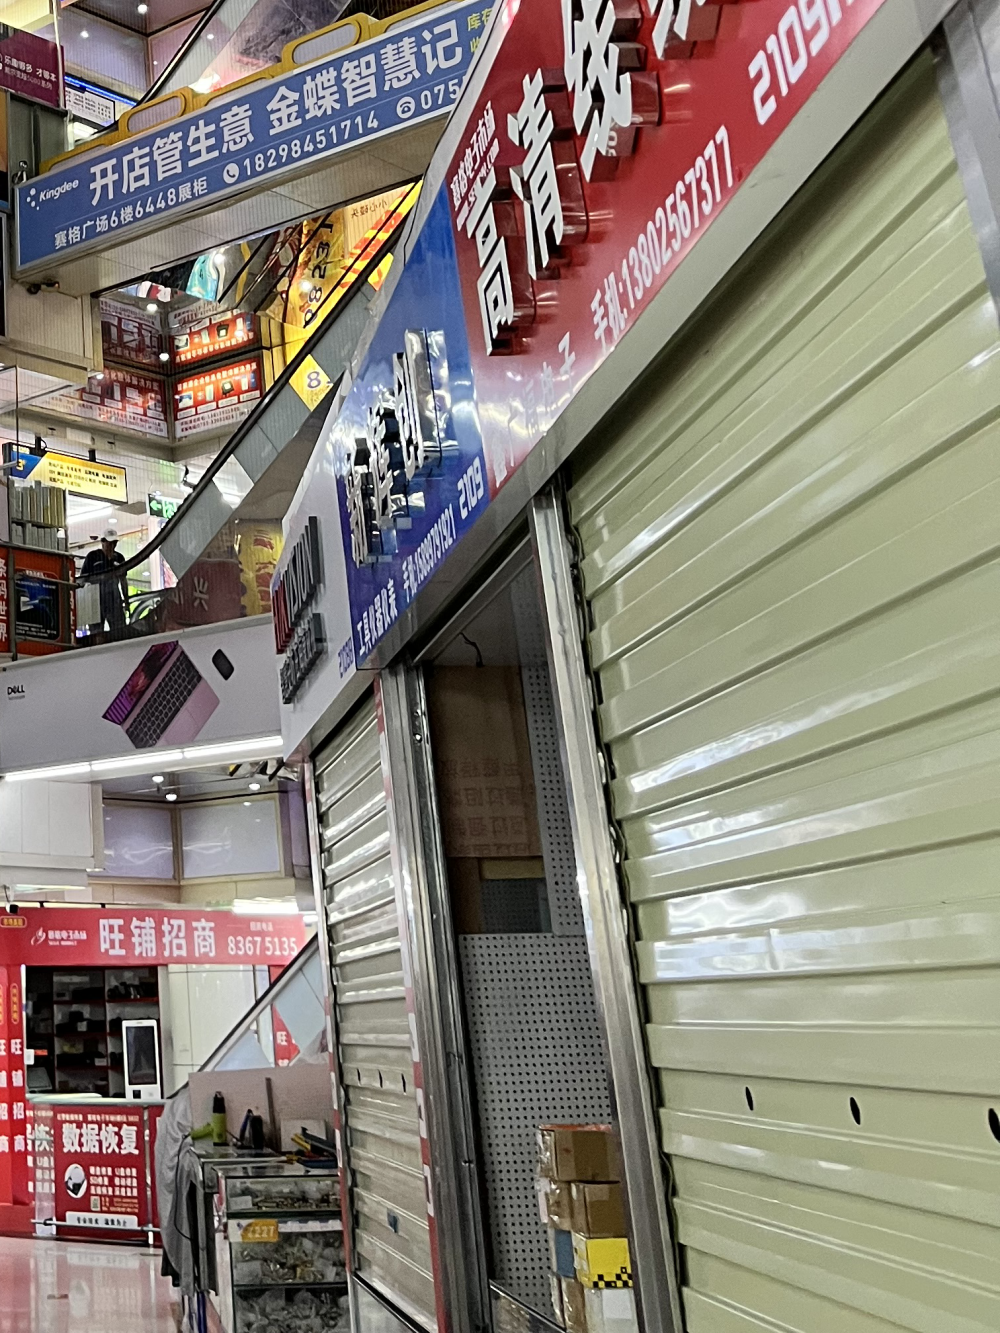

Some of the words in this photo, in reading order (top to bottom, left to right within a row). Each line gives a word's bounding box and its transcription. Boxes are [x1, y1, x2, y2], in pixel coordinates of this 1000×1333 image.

[88, 102, 254, 207] 开店管生意
[266, 18, 463, 132] 金蝶智慧记
[38, 176, 80, 204] Kingdee
[53, 176, 209, 251] 赛格广场6楼6448展柜
[243, 109, 380, 175] 18298451714
[419, 76, 465, 111] 075
[590, 124, 735, 348] 手机:13802567377
[356, 577, 398, 657] 工具仪器仪表
[457, 456, 485, 521] 2109
[7, 684, 26, 695] DELL
[99, 916, 217, 959] 旺铺招商
[227, 936, 261, 956] 8367
[265, 936, 298, 956] 5135
[10, 1037, 26, 1154] 旺铺招商
[62, 1122, 140, 1155] 数据恢复
